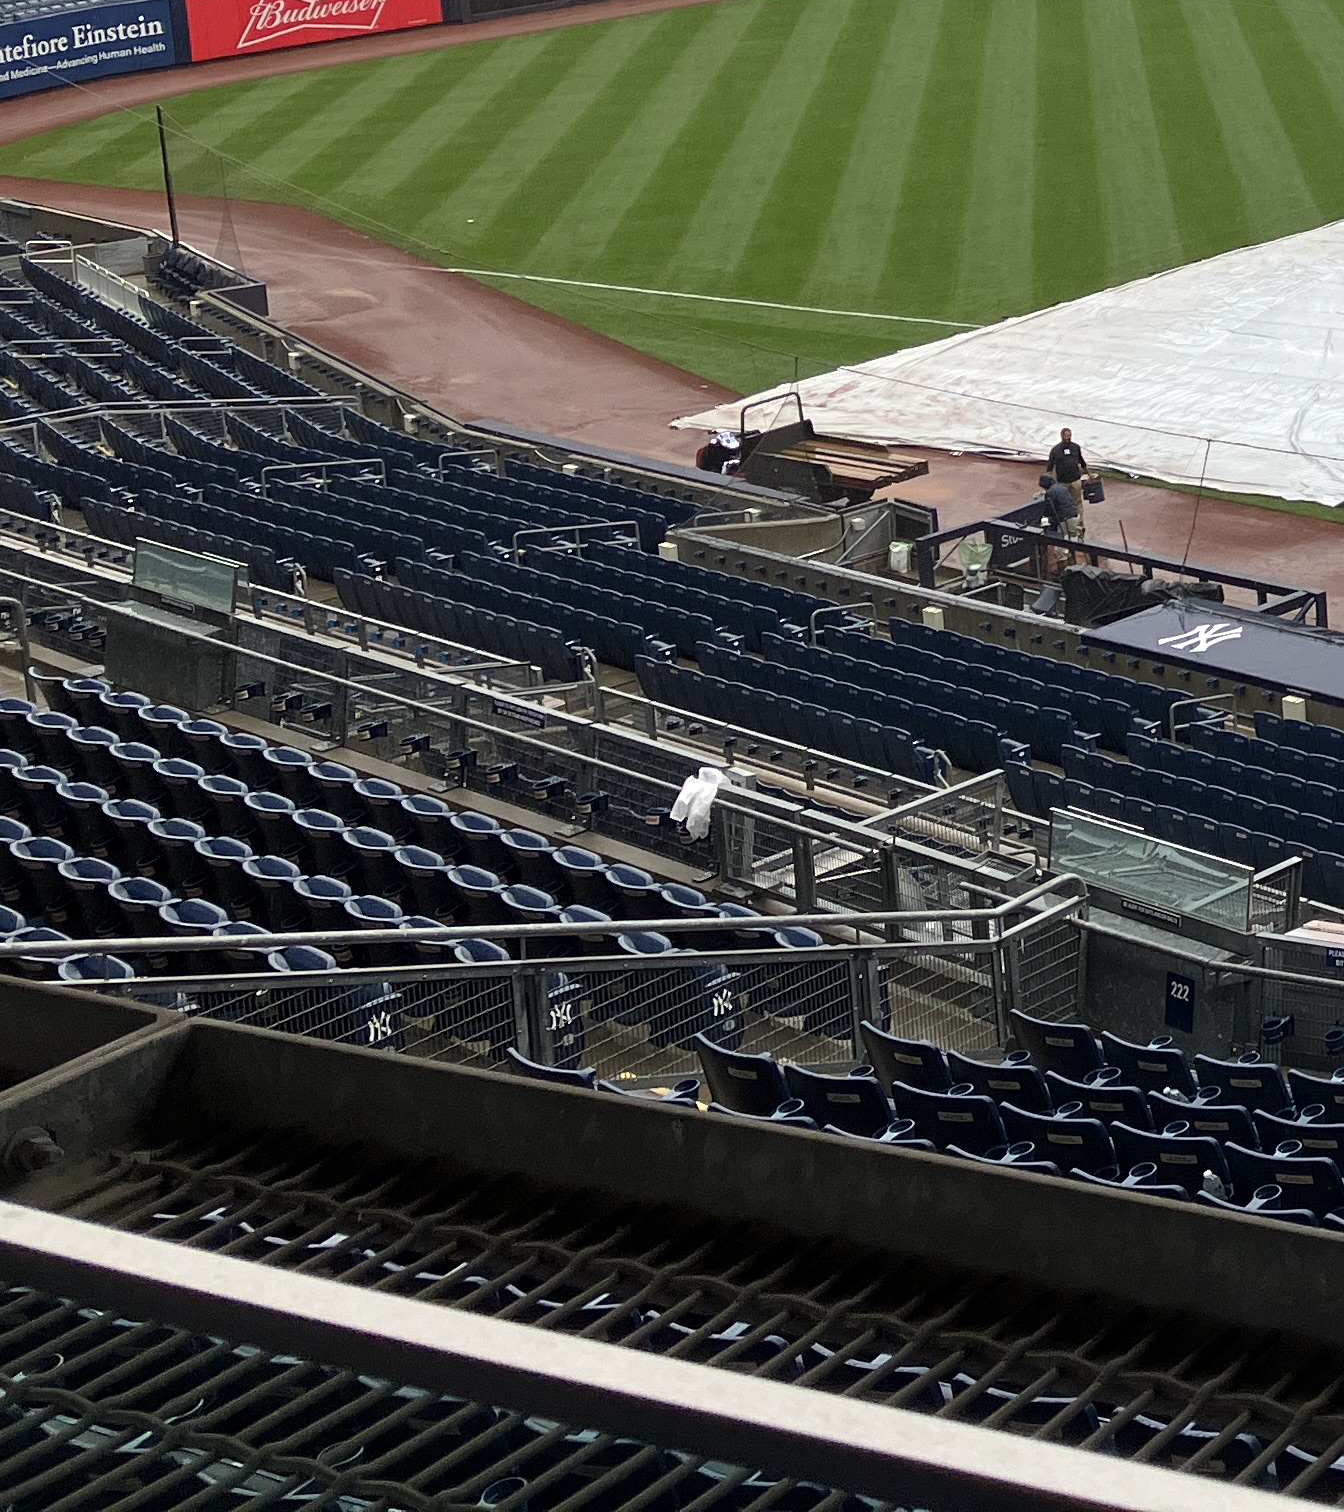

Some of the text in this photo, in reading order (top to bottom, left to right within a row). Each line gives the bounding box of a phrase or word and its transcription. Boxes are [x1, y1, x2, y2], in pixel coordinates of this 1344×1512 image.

[71, 15, 164, 46] Einstein
[98, 42, 165, 62] Human Health
[1158, 623, 1242, 652] NY
[1171, 981, 1189, 1002] 222
